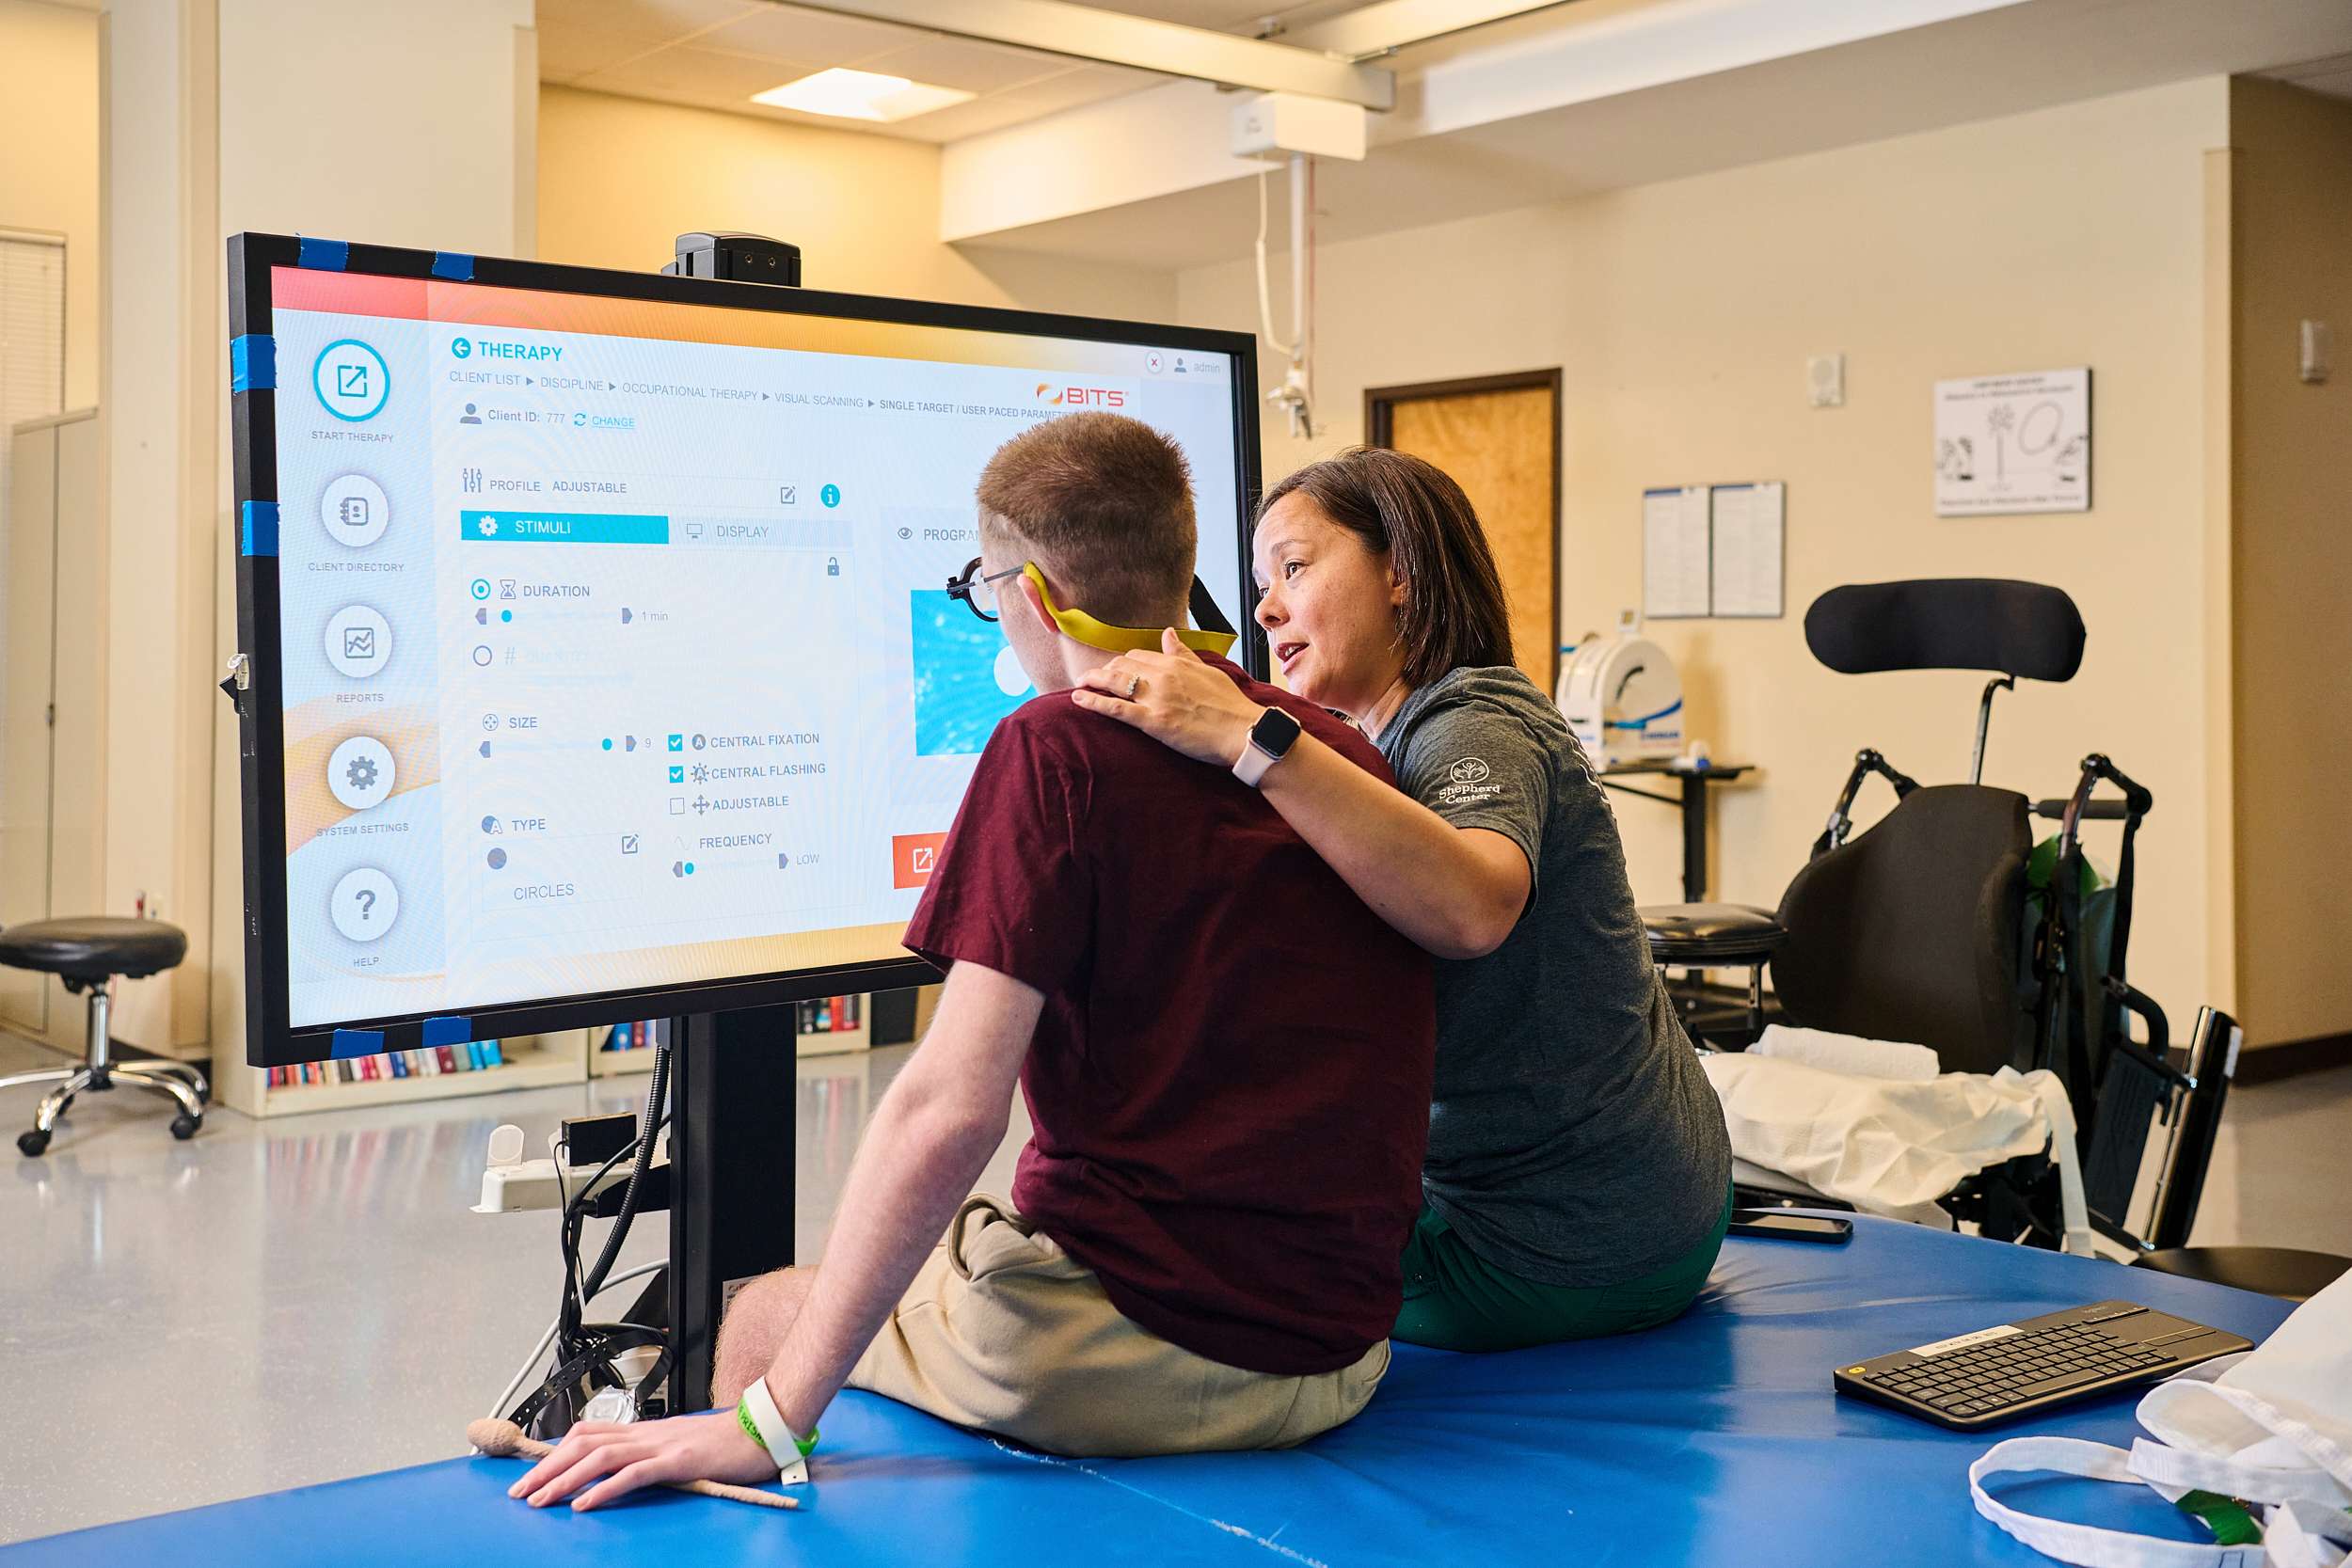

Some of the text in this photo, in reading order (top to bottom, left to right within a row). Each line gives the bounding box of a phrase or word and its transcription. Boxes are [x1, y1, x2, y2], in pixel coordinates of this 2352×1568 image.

[478, 341, 563, 362] THERAPY
[1193, 361, 1220, 373] admin
[449, 371, 492, 385] CLIENT
[496, 374, 520, 387] LIST
[540, 376, 604, 392] DISCIPLINE
[622, 382, 707, 399] OCCUPATIONAL
[710, 388, 758, 402] THERAPY
[774, 391, 810, 404] VISUAL
[813, 394, 864, 408] SCANNING
[880, 398, 914, 411] SINGLE
[917, 401, 954, 415] TARGET
[961, 404, 987, 416] USER
[989, 405, 1019, 418] PACED
[1067, 387, 1124, 407] BITS
[487, 409, 635, 428] Client ID: 777 CHANGE
[311, 431, 393, 443] START THERAPY
[489, 479, 628, 494] PROFILE ADJUSTABLE
[515, 519, 769, 539] STIMULI DISPLAY
[923, 529, 979, 542] PROGRA
[308, 562, 405, 572] CLIENT DIRECTORY
[523, 584, 591, 598] DURATION
[649, 610, 669, 622] min
[336, 693, 385, 704] REPORTS
[508, 717, 538, 729] SIZE
[645, 737, 651, 748] 9
[710, 733, 819, 749] CENTRAL FIXATION
[711, 762, 826, 780] CENTRAL FLASHING
[1438, 784, 1501, 800] Shepherd
[1445, 793, 1491, 804] Center
[712, 796, 789, 811] ADJUSTABLE
[316, 822, 409, 837] SYSTEM SETTINGS
[511, 817, 546, 832] TYPE
[699, 832, 772, 849] FREQUENCY
[796, 853, 820, 866] LOW
[514, 883, 575, 901] CIRCLES
[353, 957, 380, 968] HELP
